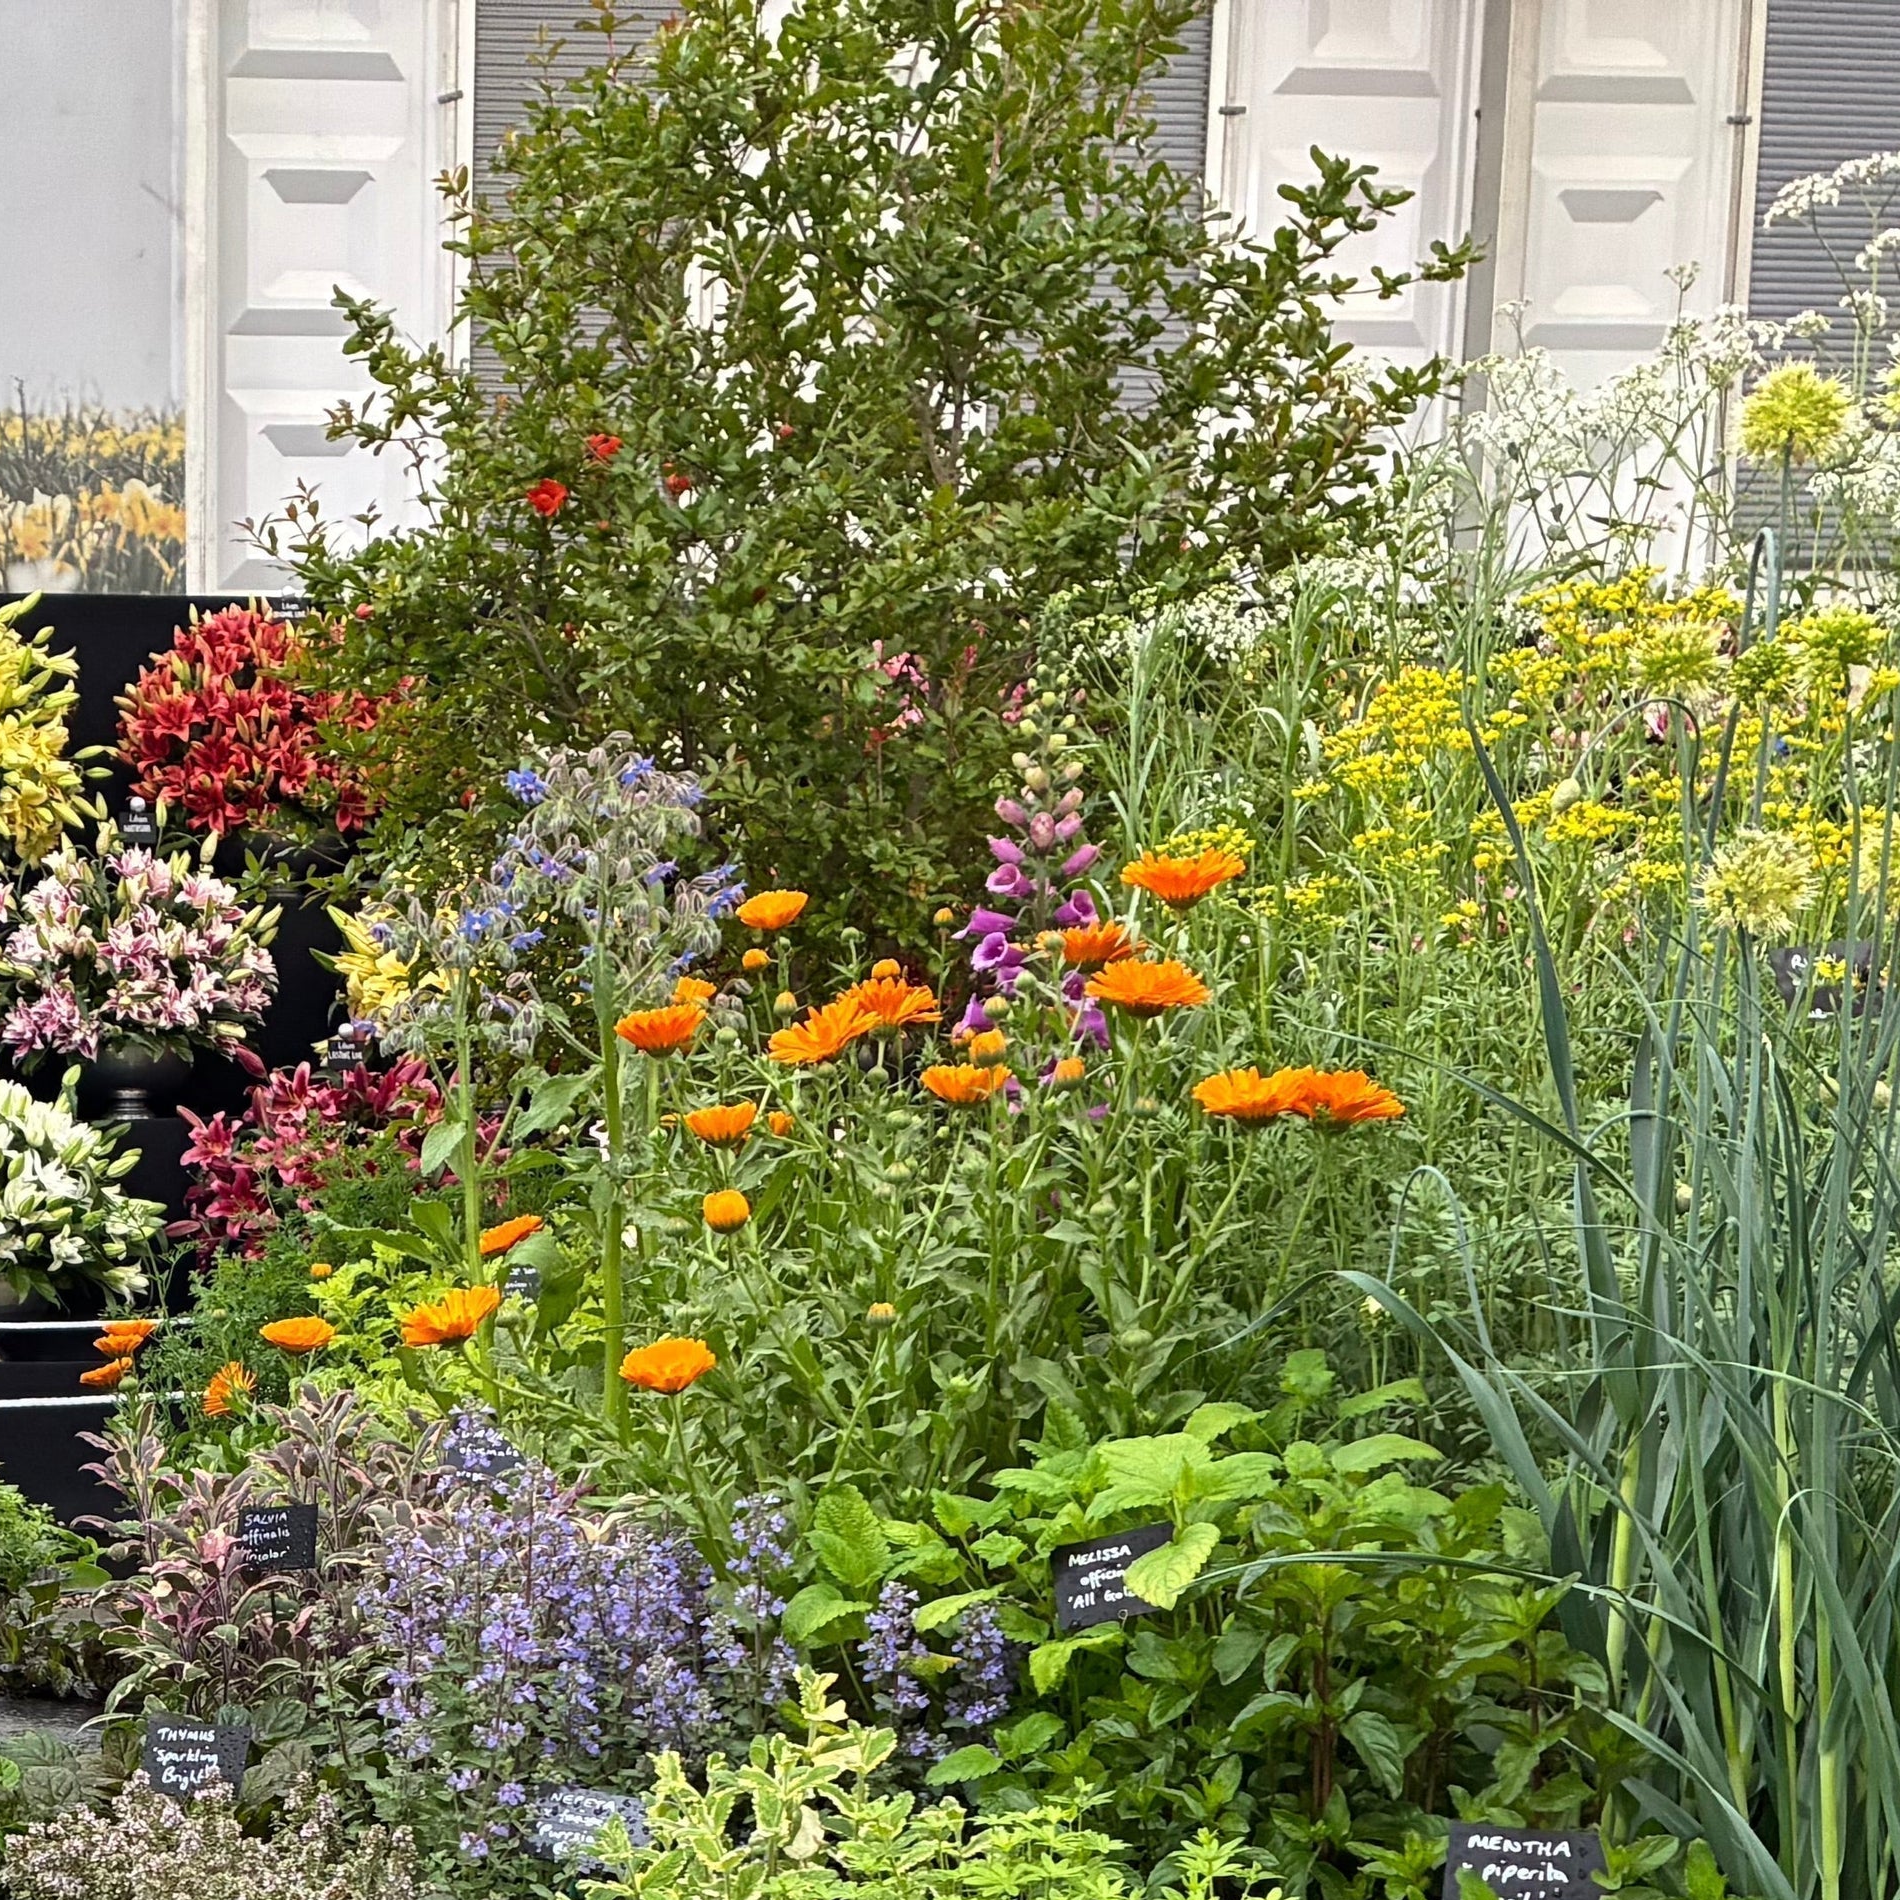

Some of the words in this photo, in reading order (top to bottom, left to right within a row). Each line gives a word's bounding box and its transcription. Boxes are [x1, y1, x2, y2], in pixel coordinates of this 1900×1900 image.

[244, 1512, 288, 1527] SALVIA
[1068, 1545, 1132, 1567] MELISSA
[157, 1727, 216, 1742] THYMUS
[550, 1792, 615, 1813] NEPETA
[1467, 1834, 1572, 1858] MENTHA
[1482, 1862, 1570, 1884] piperita
